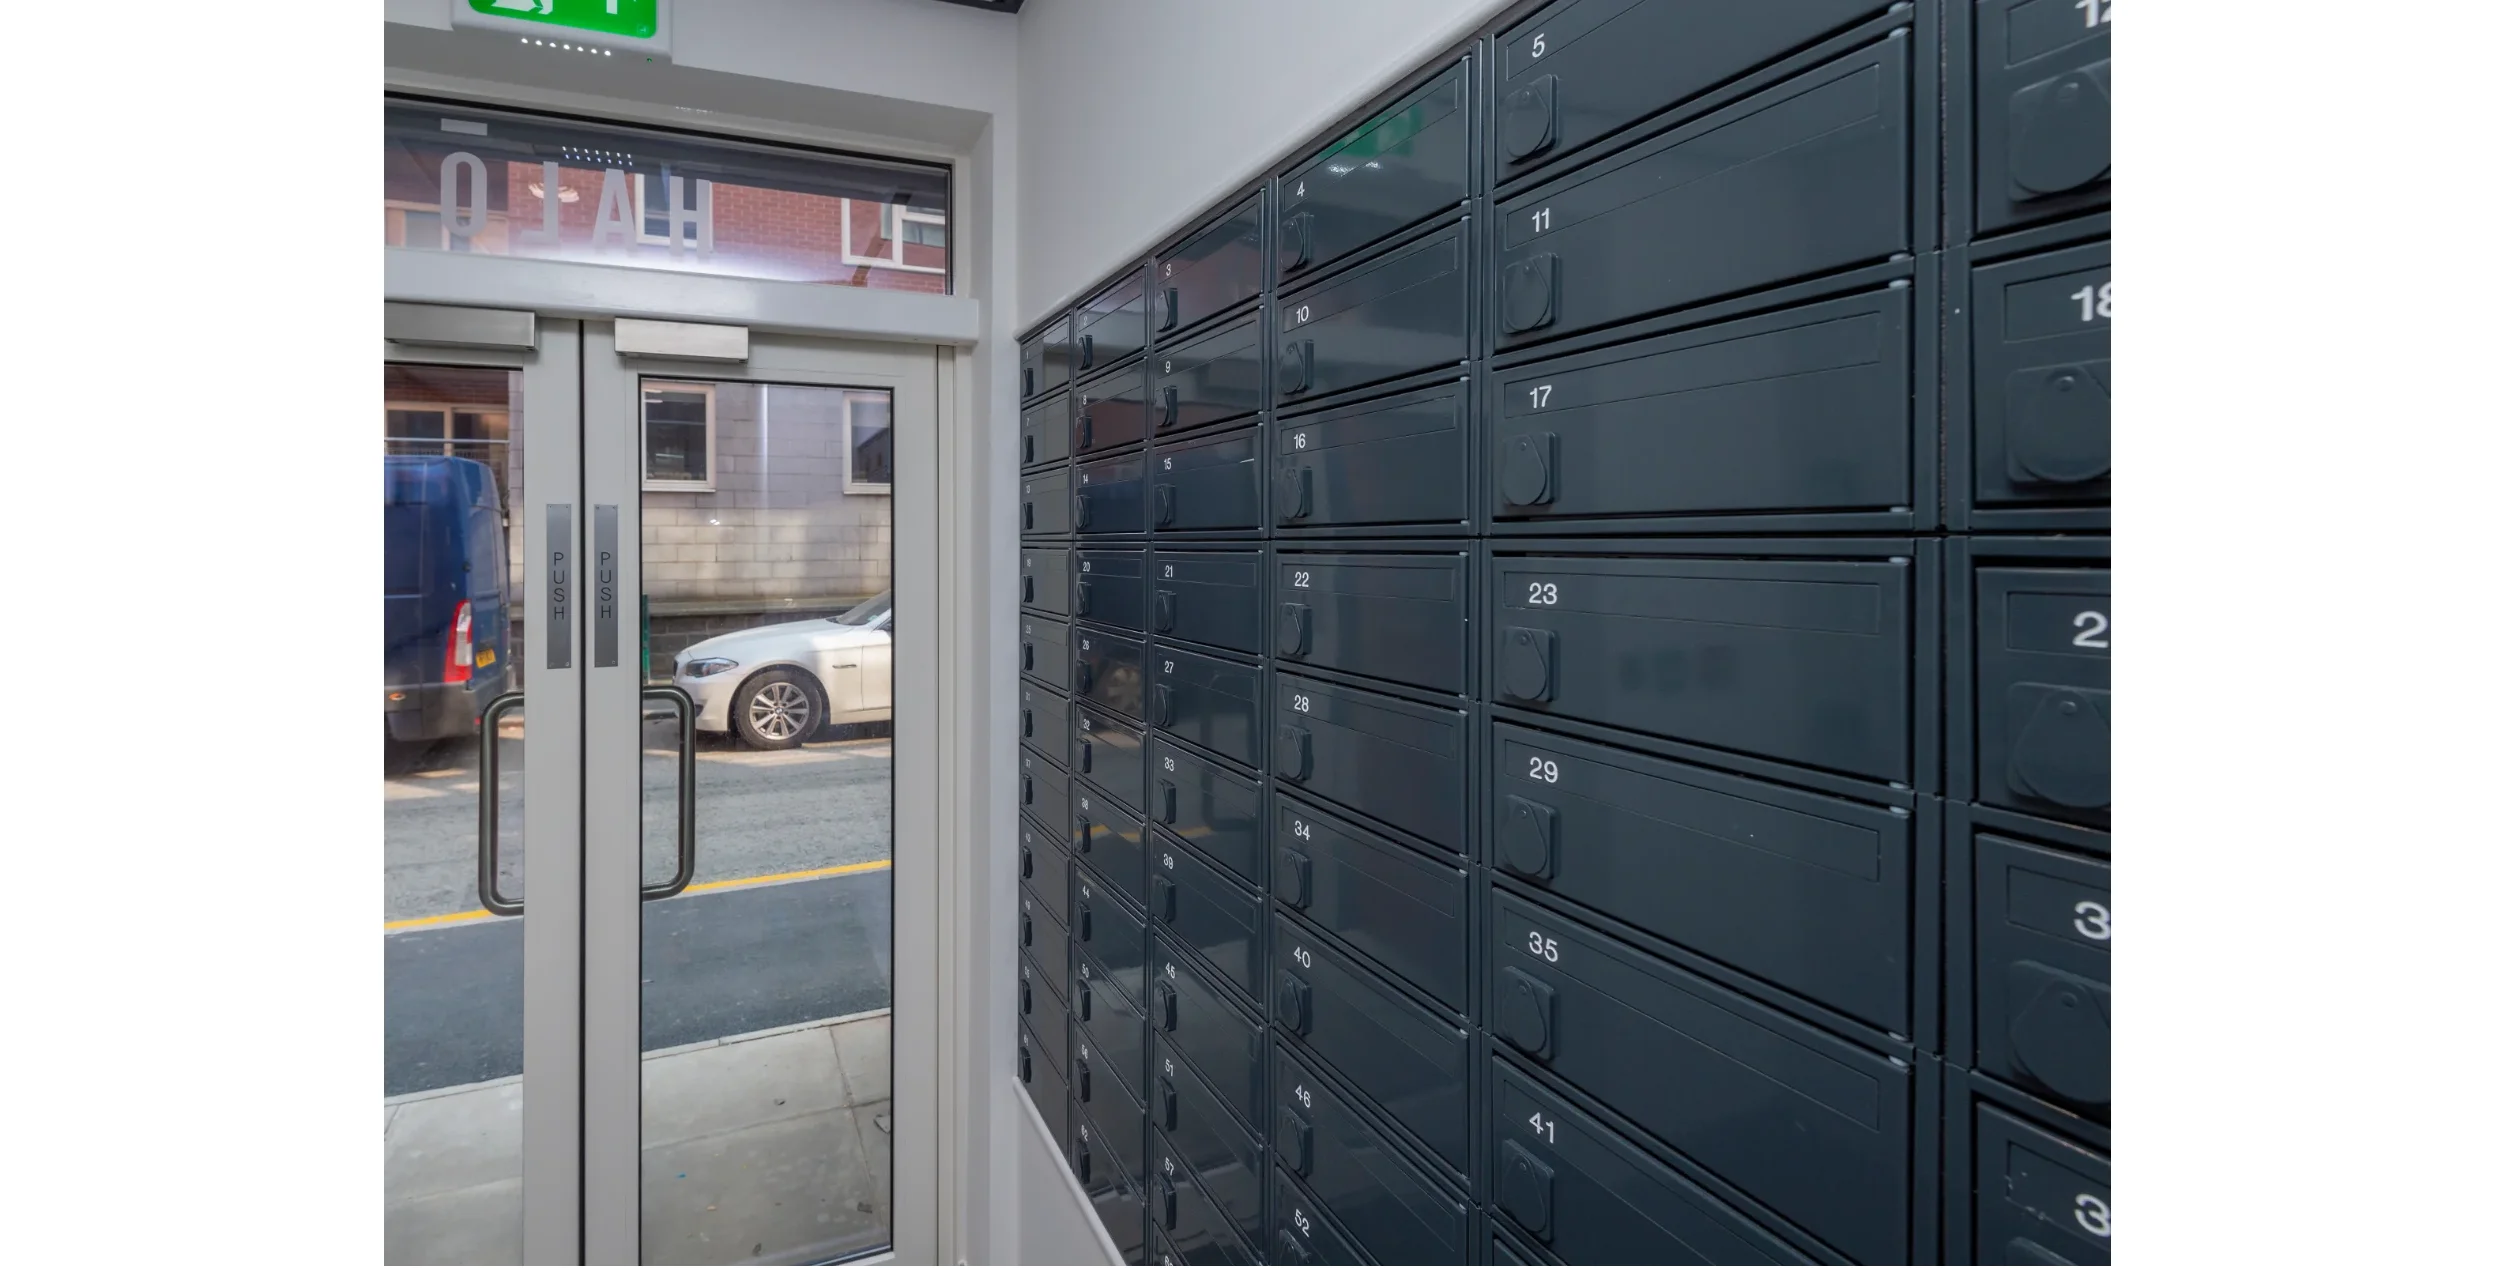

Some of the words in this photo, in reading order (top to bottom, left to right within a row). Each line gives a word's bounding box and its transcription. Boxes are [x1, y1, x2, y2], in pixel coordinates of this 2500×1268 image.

[2075, 0, 2111, 28] 1
[1531, 32, 1546, 58] 5
[1296, 181, 1306, 197] 4
[1531, 207, 1550, 233] 11
[1165, 263, 1172, 277] 3
[1296, 305, 1310, 324] 10
[1165, 360, 1171, 374] 9
[1529, 384, 1553, 409] 17
[1293, 432, 1306, 450] 16
[1163, 457, 1172, 470] 15
[1164, 564, 1173, 578] 21
[1294, 571, 1310, 588] 22
[553, 551, 565, 621] PUSH
[600, 551, 612, 619] PUSH
[1528, 582, 1558, 605] 23
[1164, 660, 1174, 674] 27
[1293, 694, 1310, 713] 28
[1164, 756, 1175, 772] 33
[1529, 756, 1559, 784] 29
[1294, 820, 1311, 841] 34
[1163, 853, 1174, 870] 39
[1528, 931, 1559, 963] 35
[1293, 946, 1311, 969] 40
[1165, 962, 1176, 979] 45
[1164, 1058, 1174, 1077] 51
[1294, 1084, 1311, 1109] 46
[1528, 1111, 1554, 1144] 41
[1164, 1156, 1175, 1176] 57
[1293, 1208, 1311, 1238] 52
